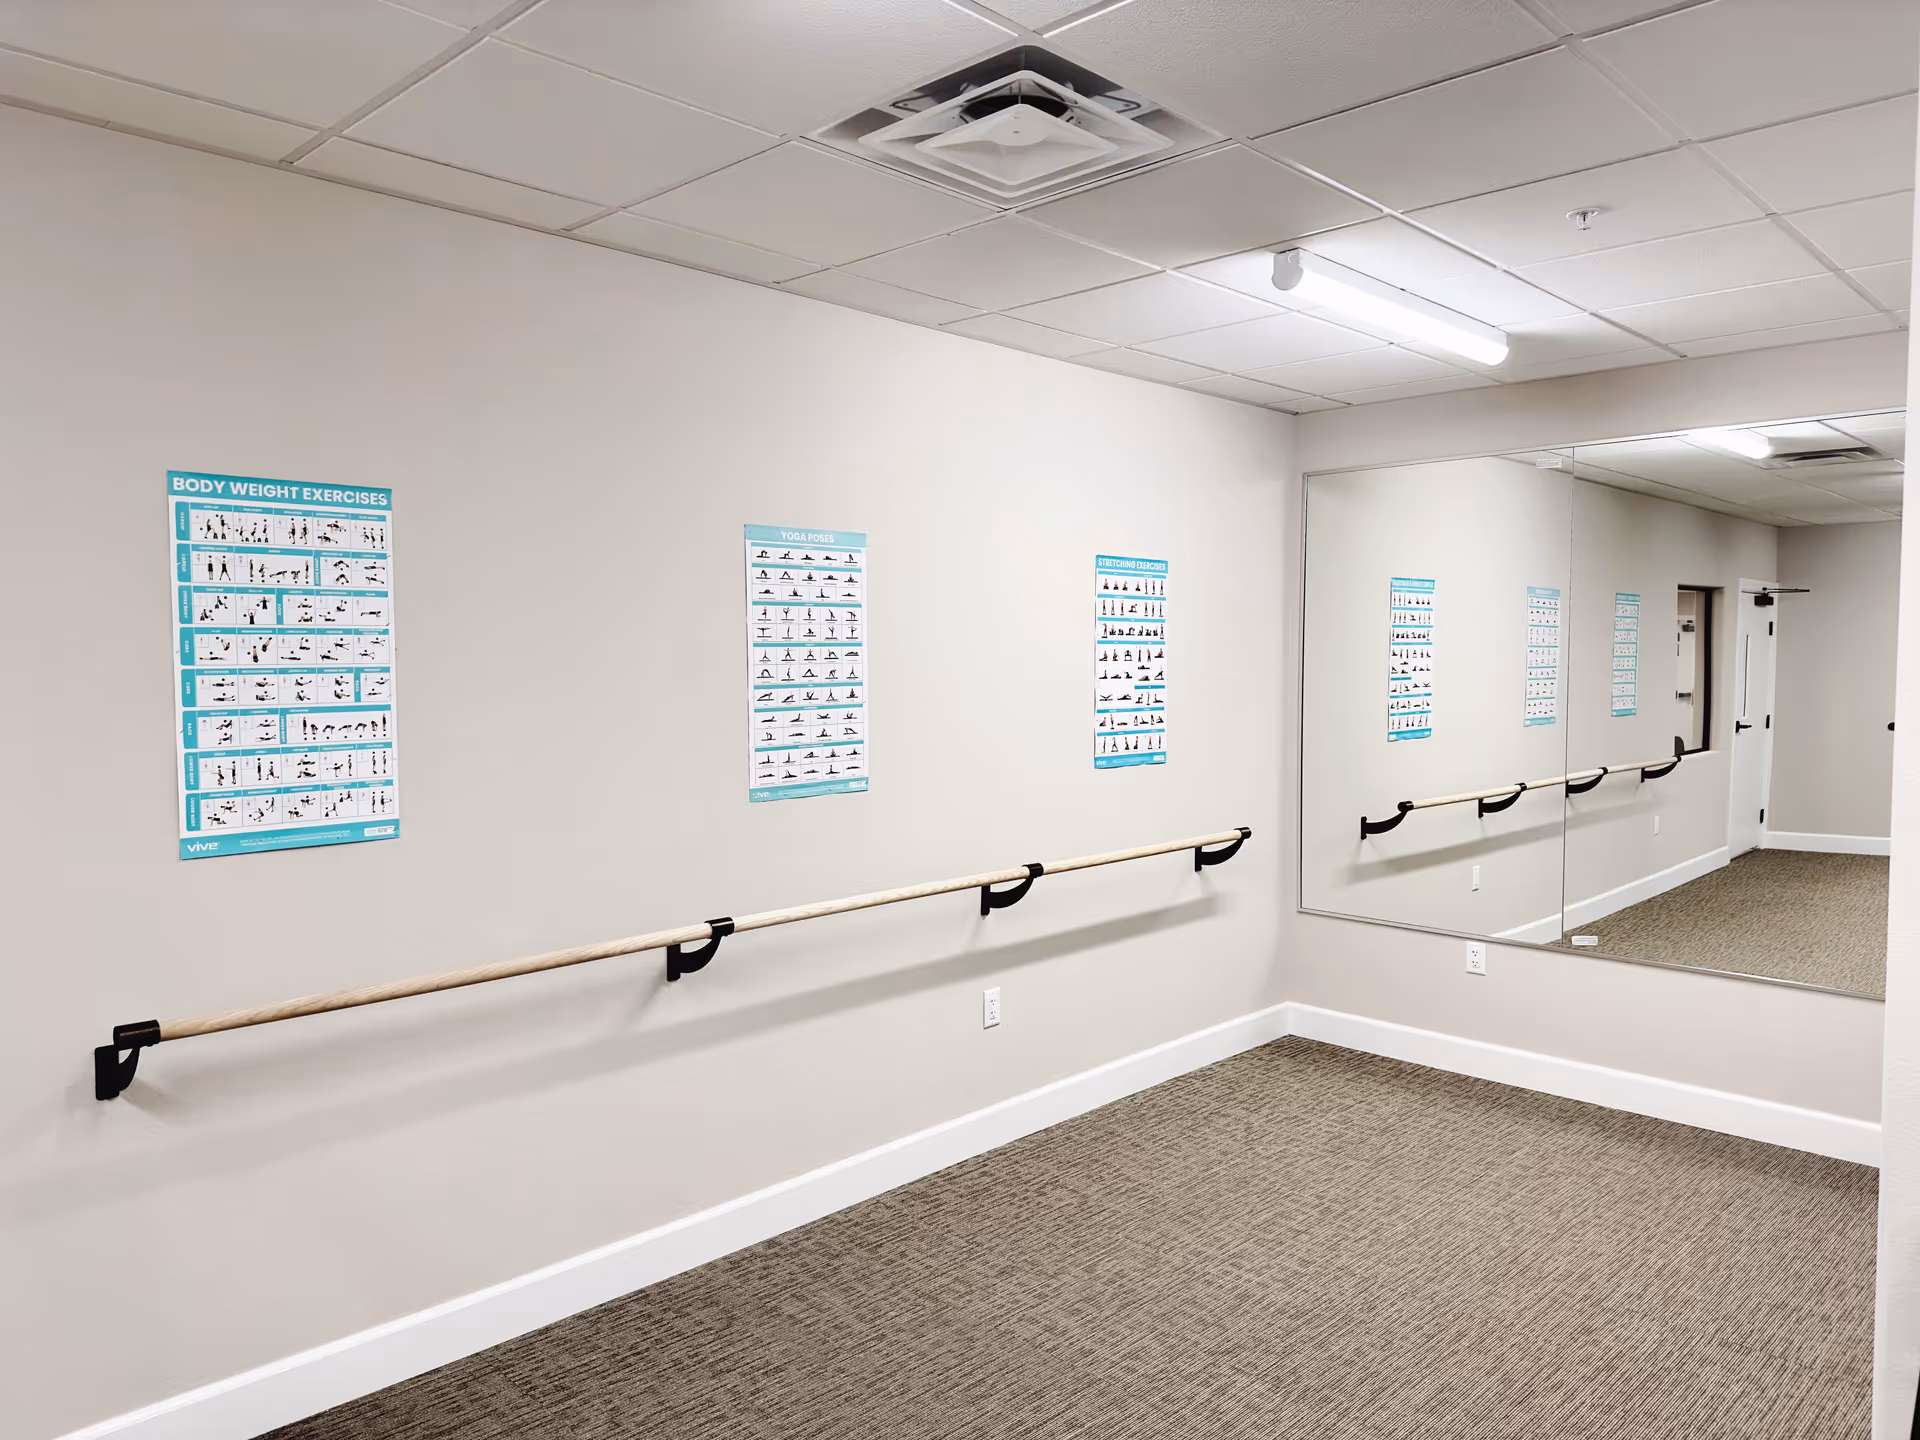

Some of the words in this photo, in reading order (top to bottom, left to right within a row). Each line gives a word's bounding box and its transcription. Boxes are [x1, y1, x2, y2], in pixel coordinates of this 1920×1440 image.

[173, 477, 226, 494] BODY
[230, 482, 299, 499] WEIGHT
[303, 487, 388, 506] EXERCISES
[781, 531, 807, 541] YOGA
[808, 533, 834, 543] POSES
[1098, 558, 1135, 568] STRETCHING
[1137, 561, 1166, 570] EXERCISES
